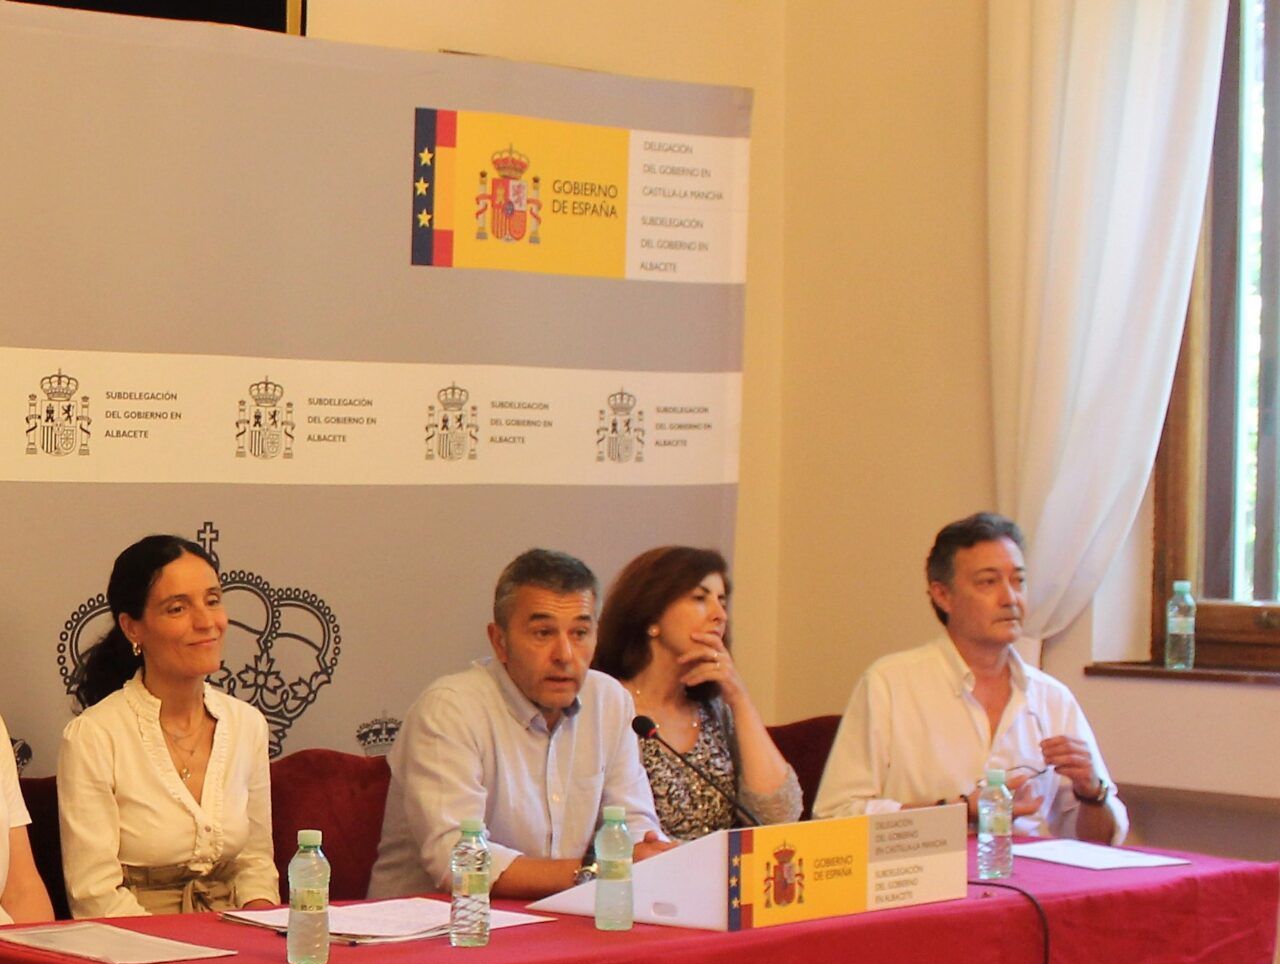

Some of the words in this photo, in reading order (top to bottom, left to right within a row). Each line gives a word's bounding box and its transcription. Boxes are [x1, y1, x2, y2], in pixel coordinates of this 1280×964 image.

[643, 140, 693, 154] DELEGACIÓN
[643, 164, 656, 176] DEL
[660, 165, 697, 177] GOBIERNO
[700, 167, 711, 178] EN
[552, 179, 618, 199] GOBIERNO
[690, 189, 724, 201] MANCHA
[552, 200, 568, 214] DE
[572, 199, 618, 219] ESPAÑA
[641, 215, 704, 229] SUBDELEGACIÓN
[641, 239, 653, 250] DEL
[657, 240, 695, 251] GOBIERNO
[698, 241, 709, 252] EN
[640, 261, 677, 273] ALBACETE
[106, 391, 178, 401] SUBDELEGACIÓN
[308, 397, 373, 407] SUBDELEGACIÓN
[105, 411, 122, 419] DEL
[124, 411, 168, 420] GOBIERNO
[170, 412, 182, 420] EN
[324, 417, 364, 425] GOBIERNO
[366, 417, 376, 425] EN
[506, 419, 542, 427] GOBIERNO
[105, 430, 149, 439] ALBACETE
[307, 434, 346, 442] ALBACETE
[490, 436, 525, 444] ALBACETE
[875, 833, 887, 842] DEL
[891, 830, 919, 841] GOBIERNO
[815, 856, 852, 867] GOBIERNO
[814, 870, 824, 881] DE
[826, 867, 852, 878] ESPAÑA
[875, 882, 888, 891] DEL
[891, 878, 919, 889] GOBIERNO
